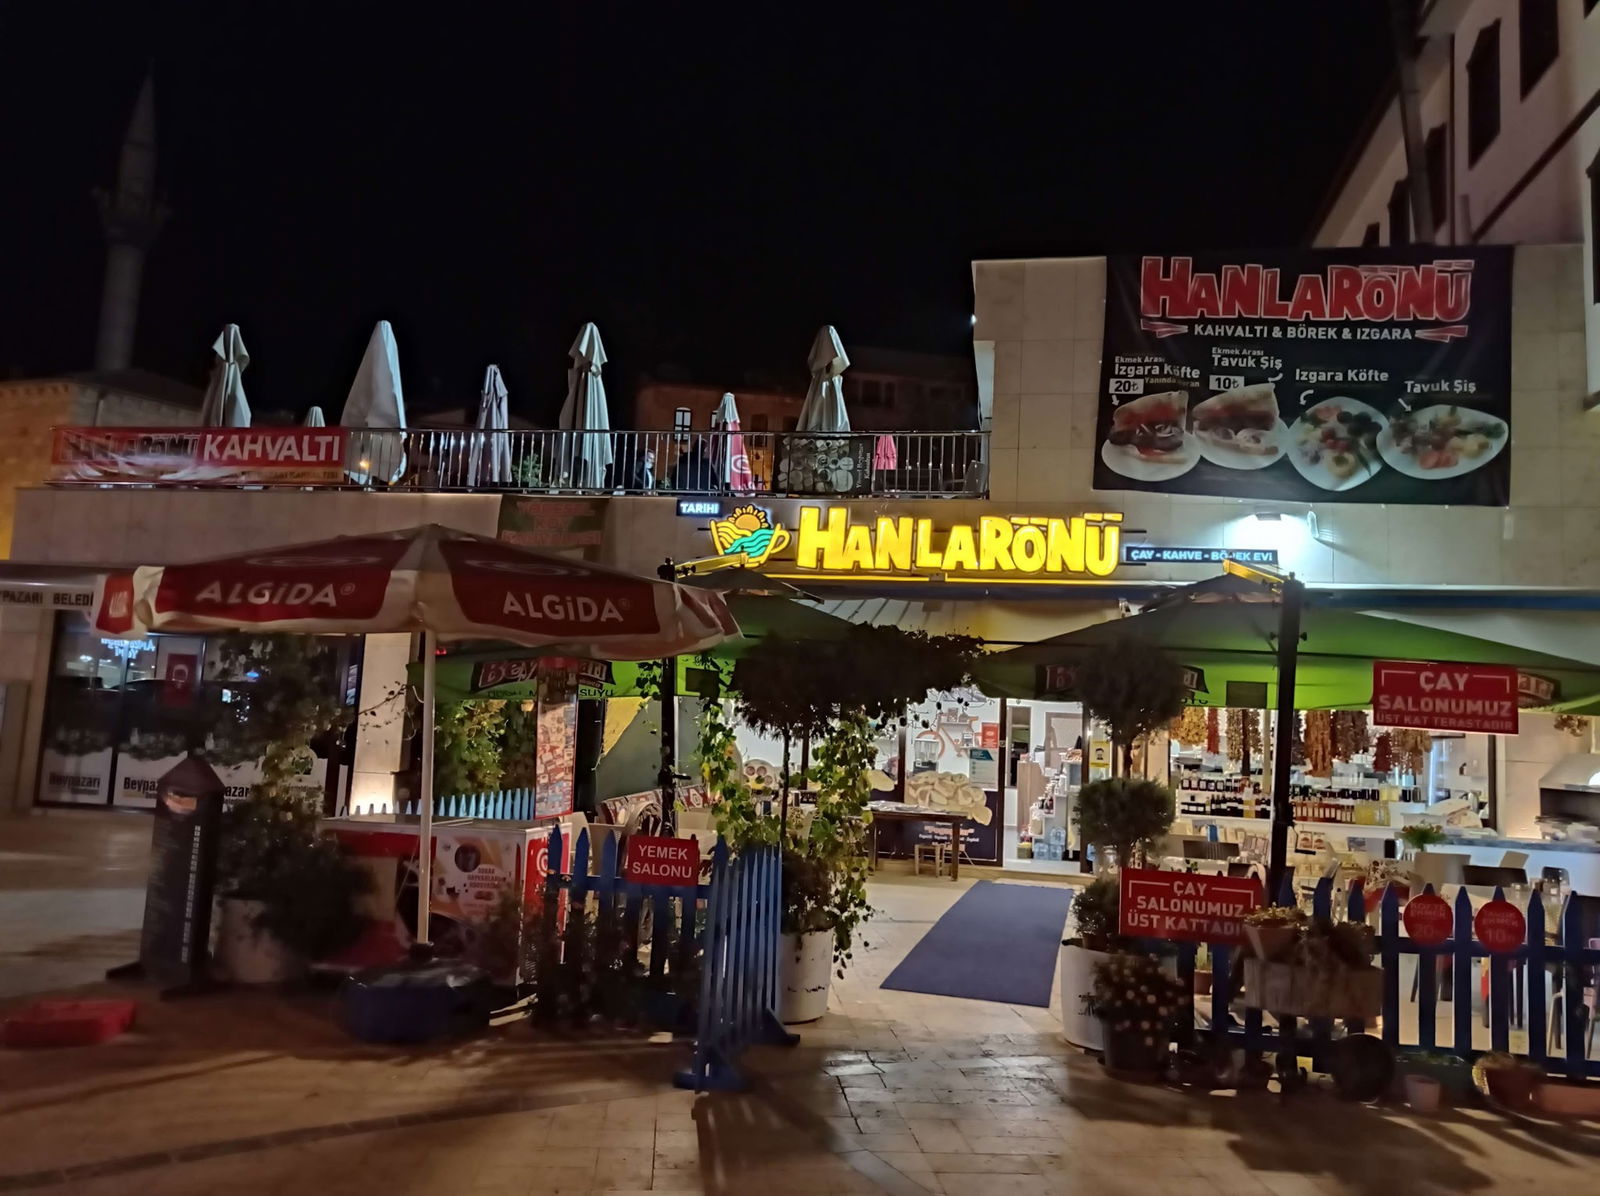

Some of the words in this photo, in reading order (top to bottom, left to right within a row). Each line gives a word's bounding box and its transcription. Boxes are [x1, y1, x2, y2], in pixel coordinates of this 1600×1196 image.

[1140, 256, 1474, 322] HANLARÖNÜ
[1194, 323, 1267, 338] KAHVALTI
[1271, 326, 1283, 338] &
[1286, 324, 1338, 339] BÖREK
[1342, 327, 1353, 340] &
[1356, 327, 1413, 340] IZGARA
[1211, 347, 1240, 355] Ekmek
[1211, 354, 1256, 368] Tavuk
[1260, 355, 1283, 370] Şiş
[1114, 363, 1160, 378] Izgara
[1164, 364, 1200, 378] Köfte
[1295, 367, 1343, 384] Izgara
[1347, 367, 1389, 382] Köfte
[1405, 380, 1449, 394] Tavuk
[1453, 380, 1477, 395] Şiş
[203, 433, 339, 462] KAHVALTI
[796, 506, 1124, 577] HANLARÖNÜ
[1131, 550, 1154, 560] ÇAY
[1162, 551, 1202, 560] KAHVE
[0, 590, 43, 604] PAZARI
[1419, 671, 1470, 692] ÇAY
[580, 688, 613, 697] SUYU
[1378, 694, 1513, 717] SALONUMUZ
[1376, 711, 1400, 723] ÜST
[1404, 715, 1430, 726] KAT
[1434, 717, 1514, 730] TERASTADIR
[638, 844, 688, 860] YEMEK
[632, 862, 692, 878] SALONU
[1173, 880, 1208, 896] ÇAY
[1137, 896, 1244, 917] SALONUMUZ
[1127, 909, 1160, 928] ÜST
